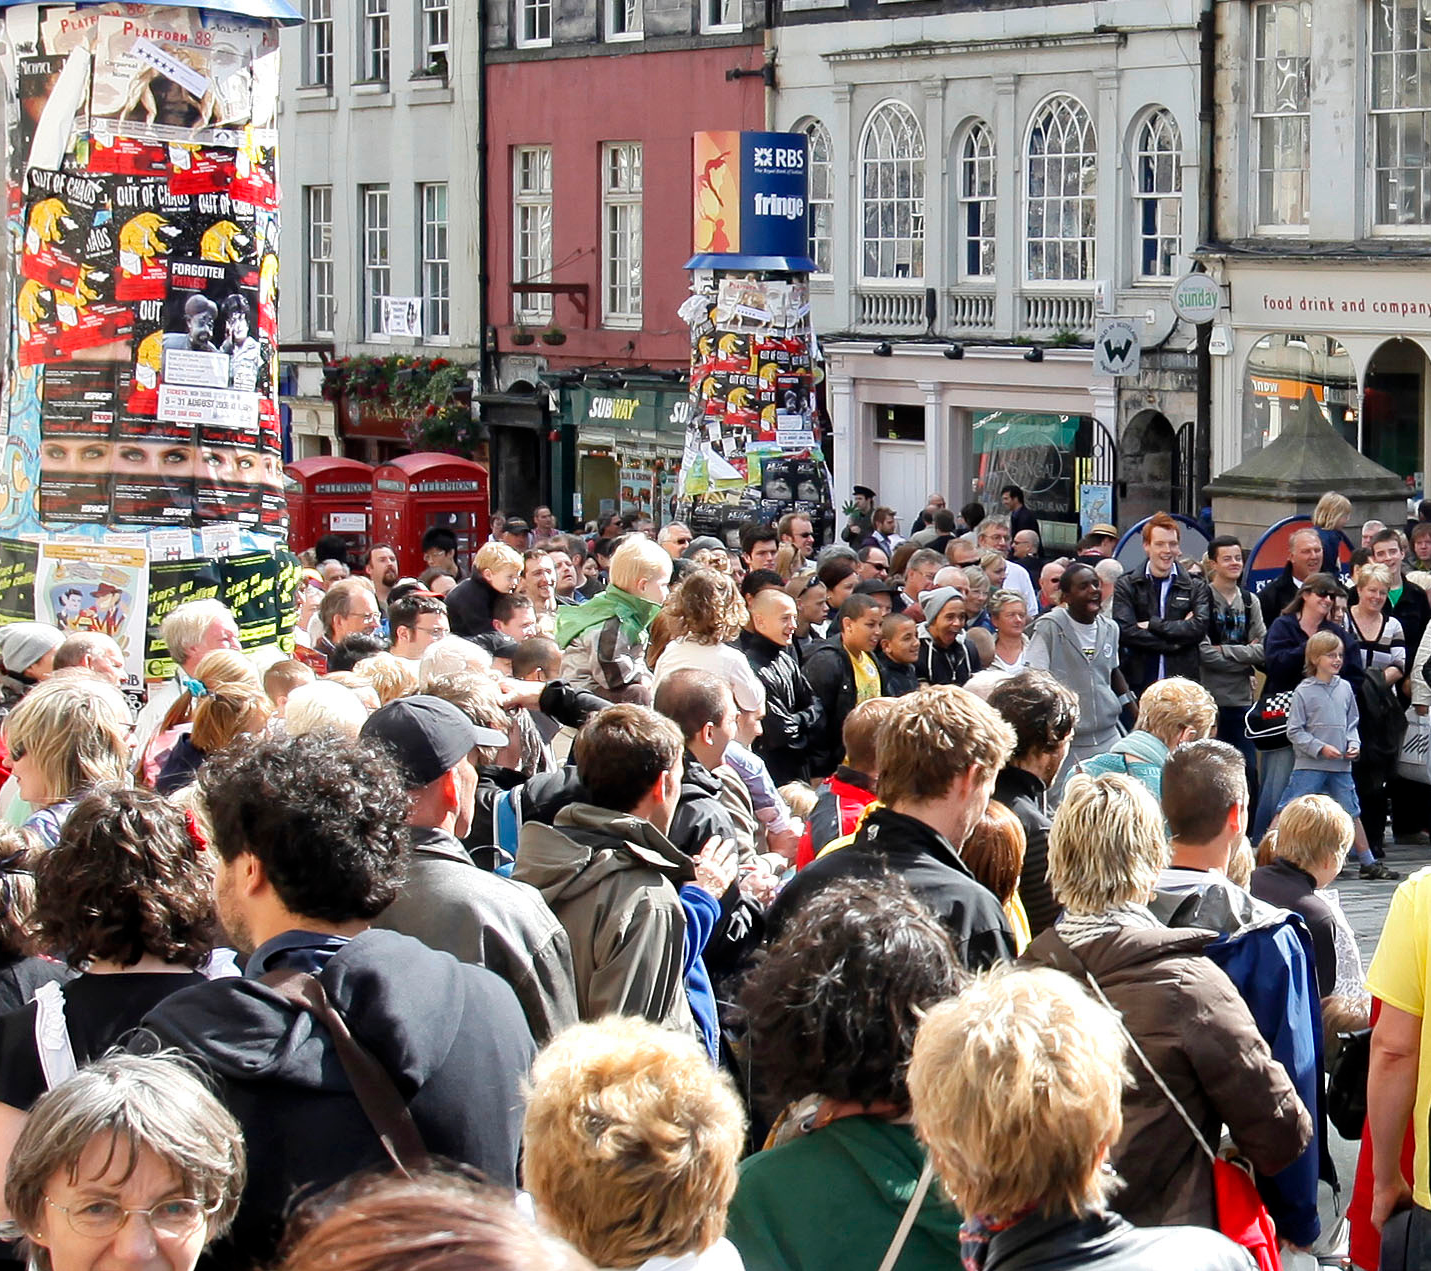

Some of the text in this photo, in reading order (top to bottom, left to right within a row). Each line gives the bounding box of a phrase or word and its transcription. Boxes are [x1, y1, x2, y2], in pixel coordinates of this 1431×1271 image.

[123, 21, 213, 47] PLATFORM 88
[775, 148, 803, 168] RBS
[32, 170, 96, 204] OUT OF CHAOS
[117, 186, 140, 207] OUT
[142, 184, 156, 207] OF
[199, 194, 219, 215] OUT
[754, 193, 803, 220] fringe
[172, 262, 225, 279] FORGOTTEN
[172, 278, 207, 289] THINGS
[1178, 288, 1218, 309] sunday
[1263, 295, 1293, 311] food
[1299, 296, 1335, 312] drink
[1341, 298, 1365, 313] and
[140, 299, 163, 322] OUT
[589, 397, 639, 420] SUBWAY
[418, 481, 478, 492] TELEPHONE
[149, 581, 194, 603] stars on
[156, 600, 178, 615] the
